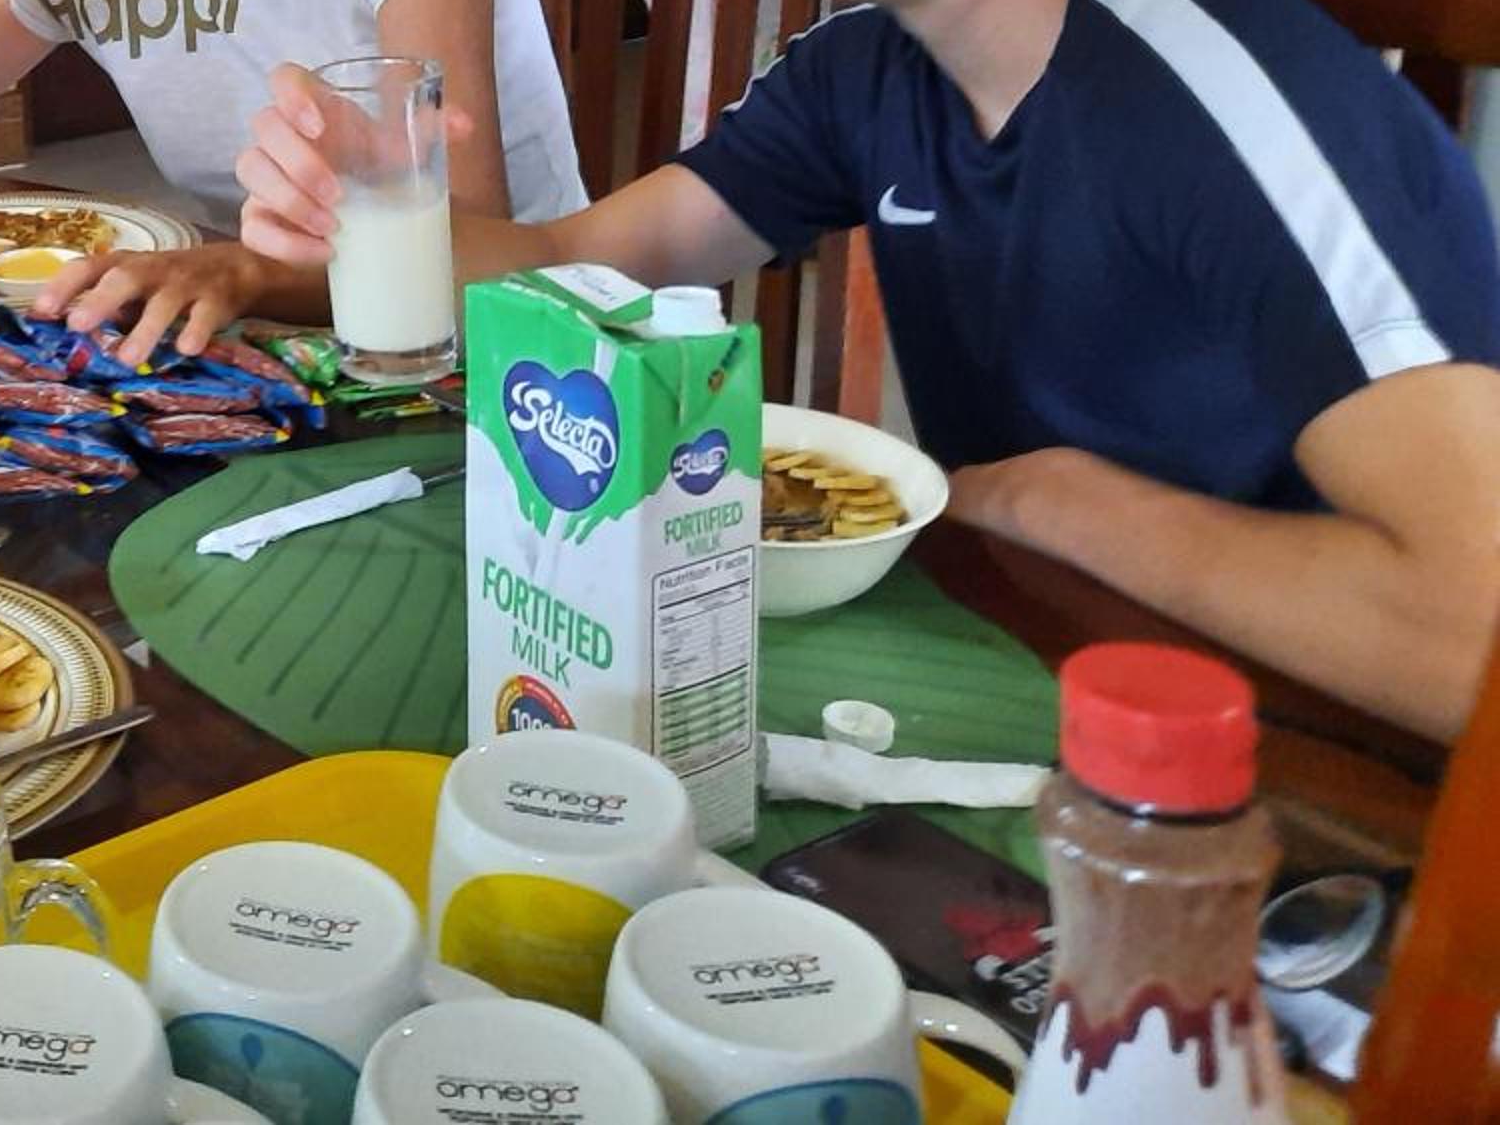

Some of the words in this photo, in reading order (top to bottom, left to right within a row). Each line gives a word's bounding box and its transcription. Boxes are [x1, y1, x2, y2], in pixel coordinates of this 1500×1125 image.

[509, 380, 617, 477] Selecta
[664, 500, 744, 547] FORTIFIED
[482, 557, 614, 671] FORTIFIED
[511, 625, 572, 689] MILK
[507, 782, 628, 815] omega
[235, 902, 362, 938] omega
[436, 1081, 580, 1114] omega
